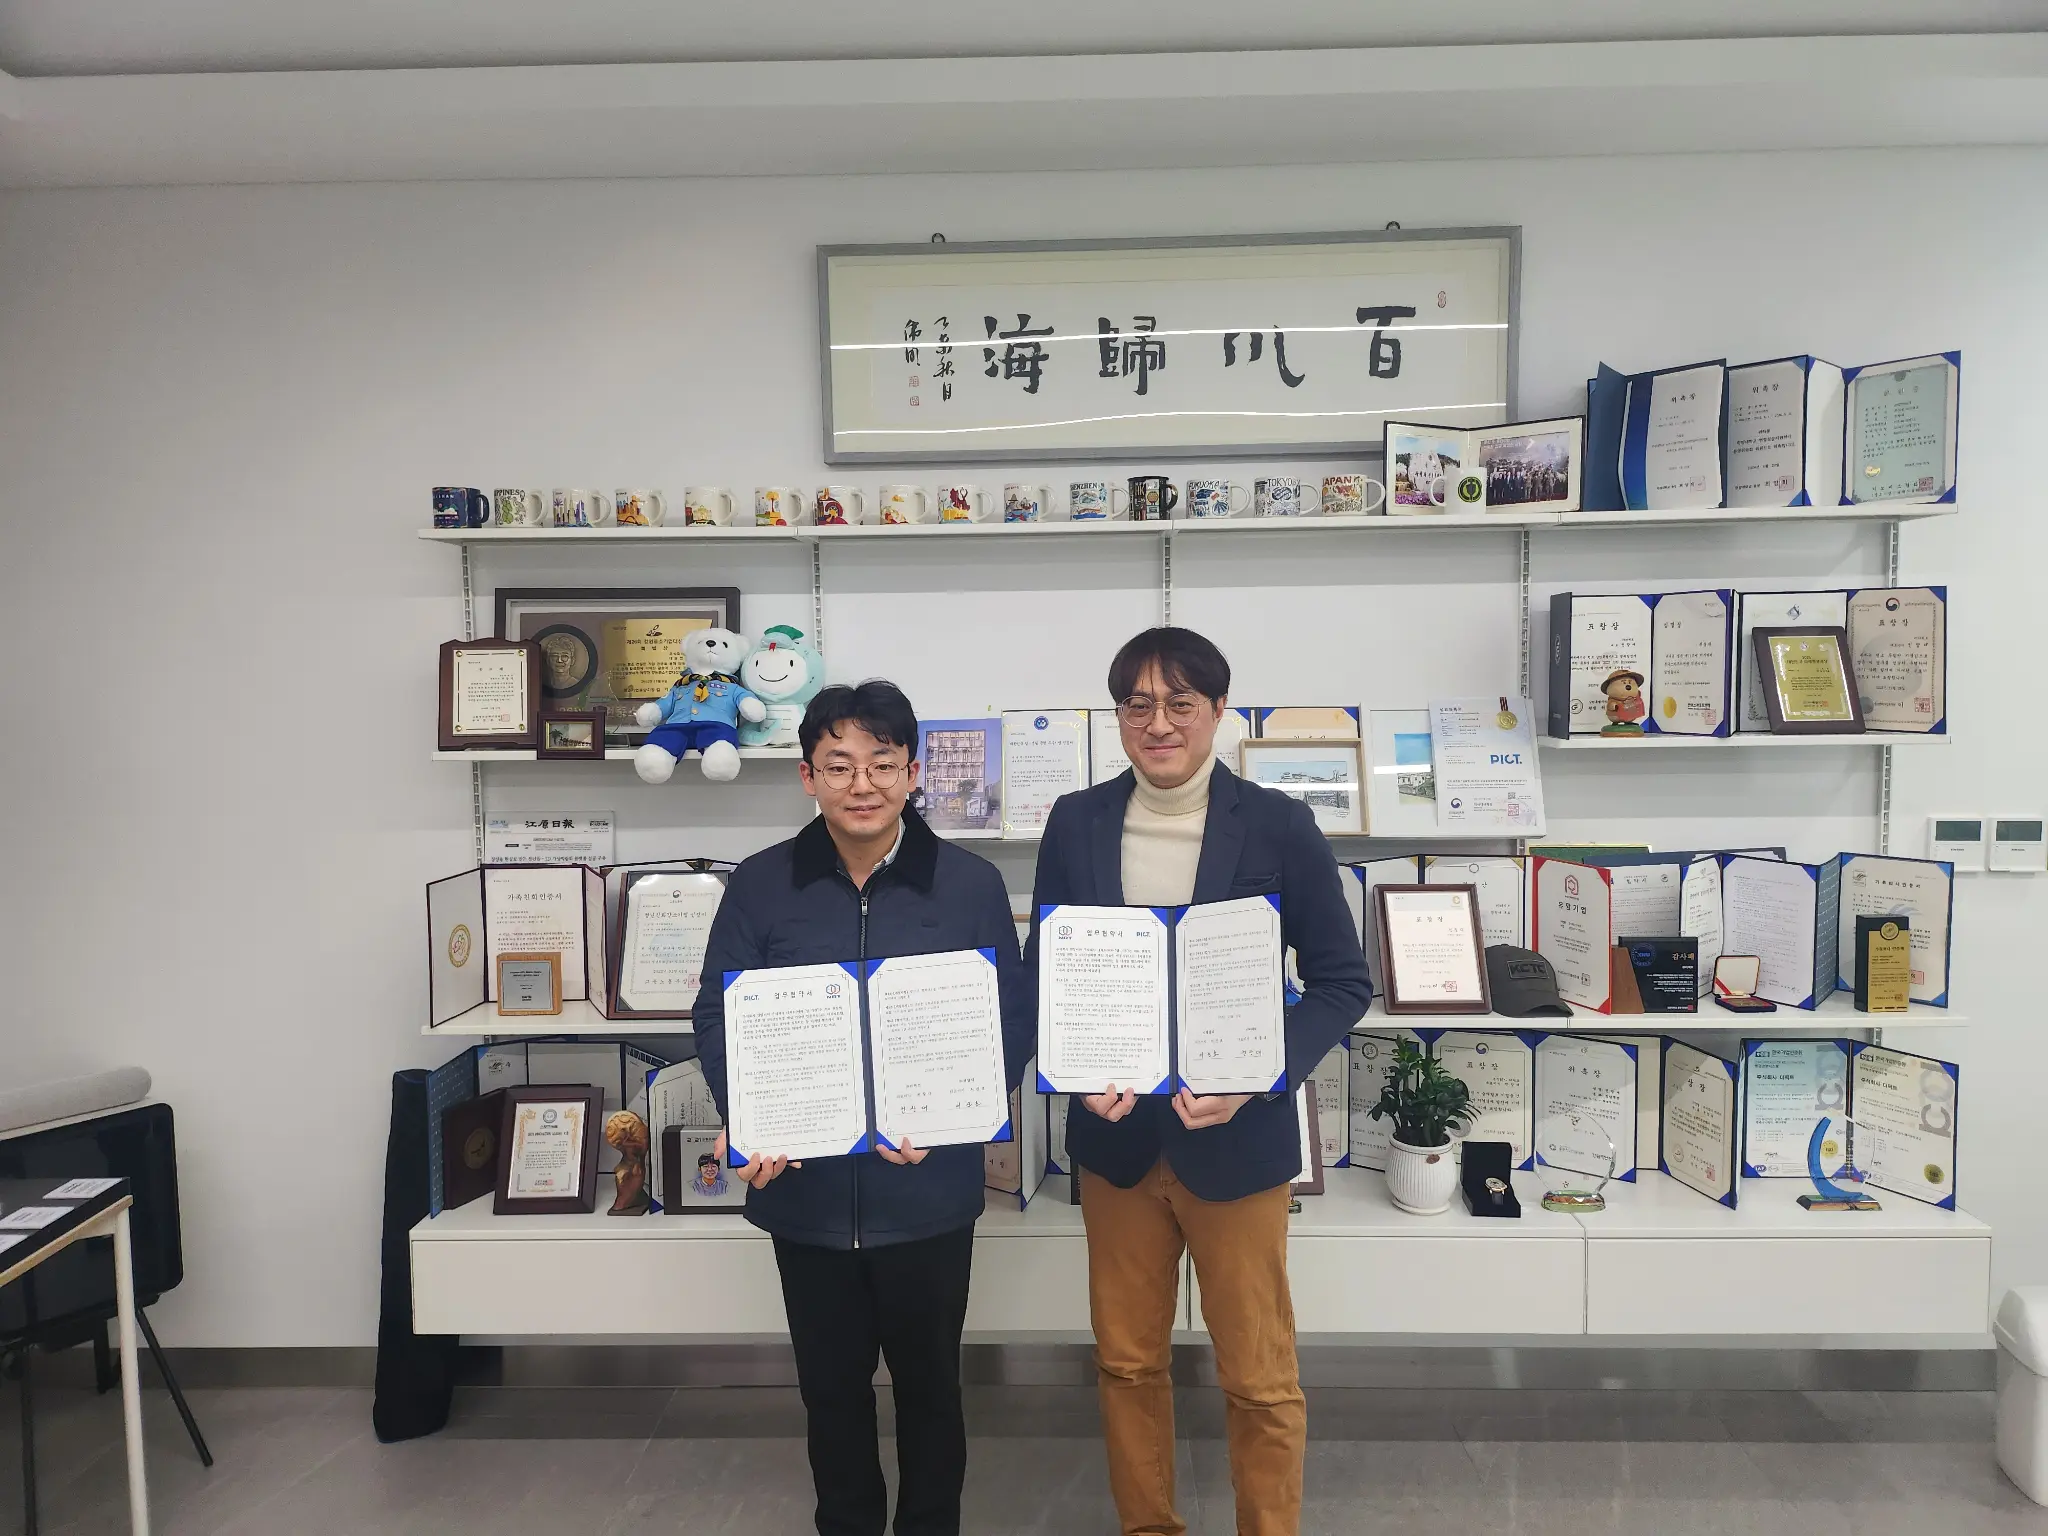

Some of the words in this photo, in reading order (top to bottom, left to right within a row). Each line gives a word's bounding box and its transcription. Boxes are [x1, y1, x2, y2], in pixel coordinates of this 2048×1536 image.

[1753, 383, 1779, 394] 위촉장
[1267, 478, 1293, 488] TOKYO
[1322, 476, 1352, 487] JAPAN
[1587, 621, 1619, 631] 표창장
[1490, 754, 1523, 765] PICT.
[525, 819, 575, 829] 江原日報
[1086, 929, 1124, 938] 업무협약서
[1672, 952, 1694, 961] 감사패
[774, 990, 813, 1000] 업무협약서
[1352, 1062, 1388, 1076] 표창장
[1466, 1061, 1499, 1071] 표창장
[1568, 1065, 1601, 1078] 위촉장
[1687, 1078, 1706, 1093] 상장
